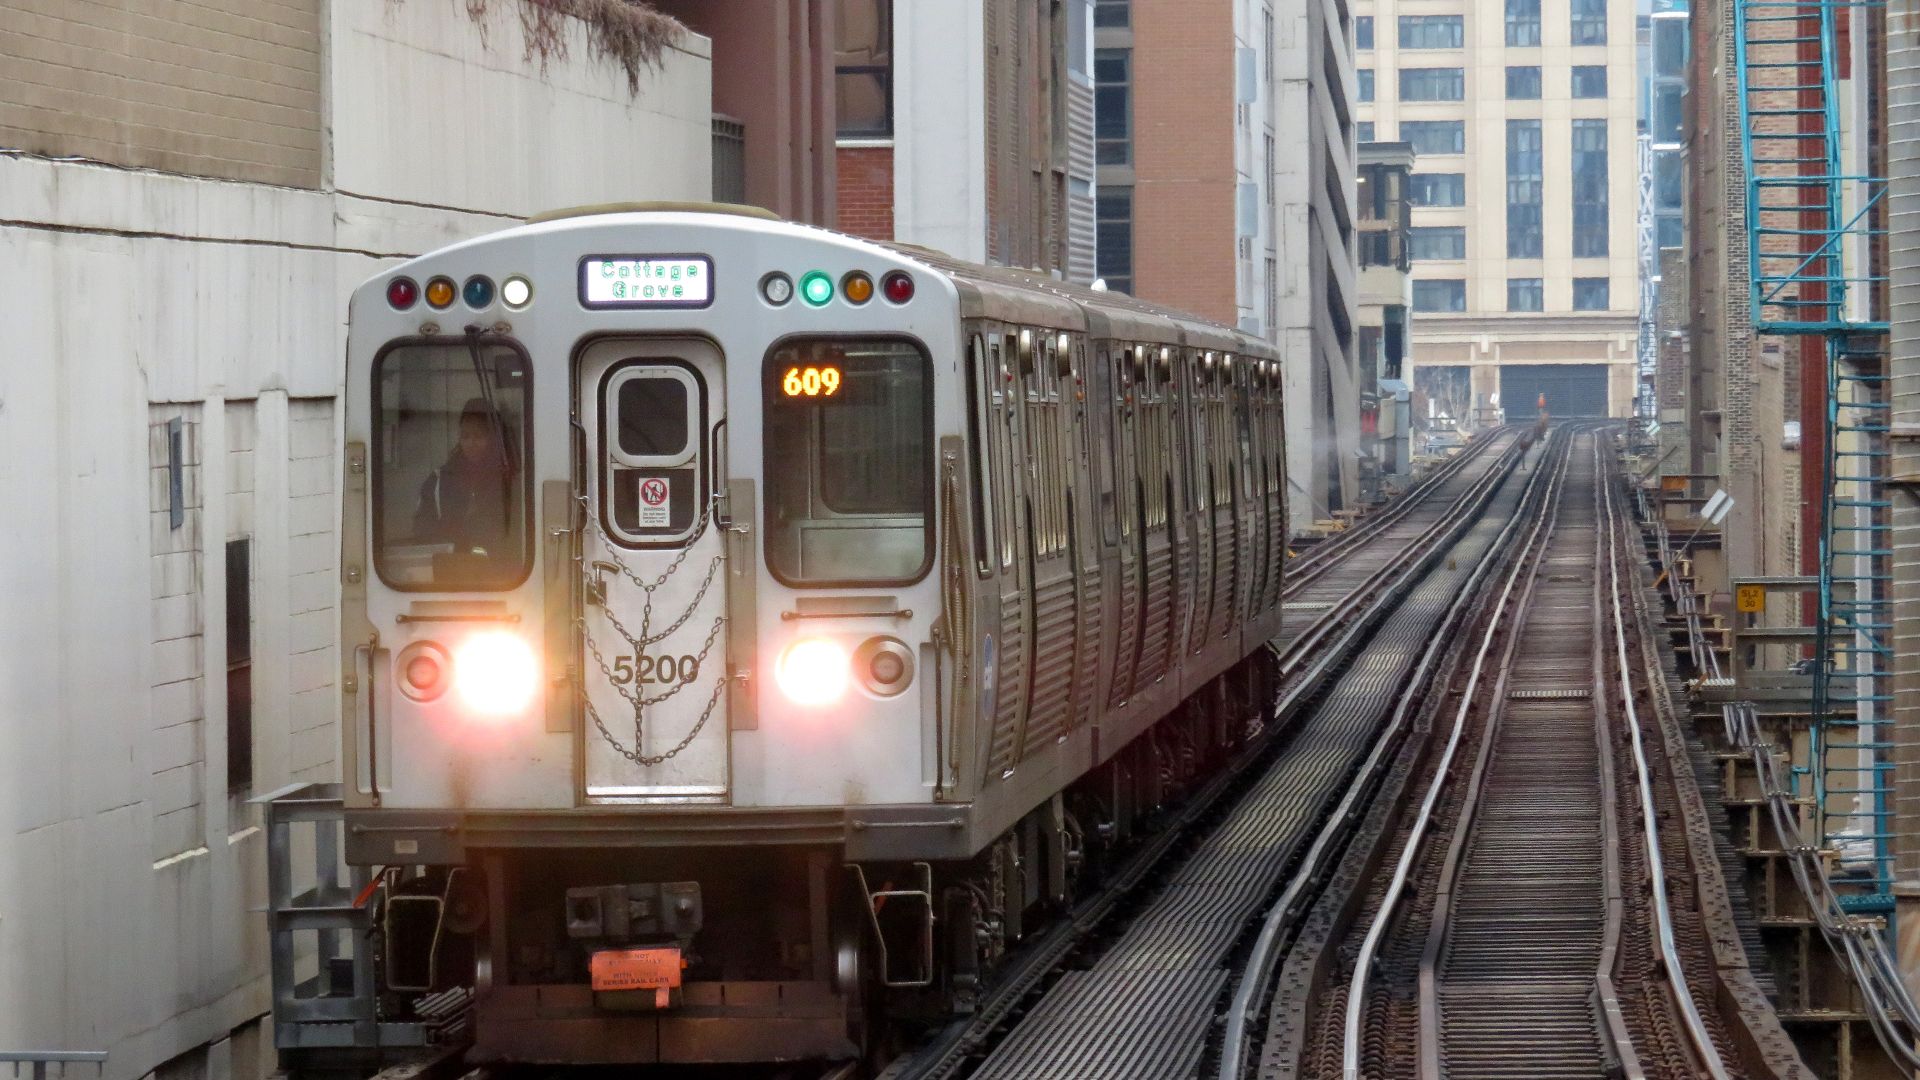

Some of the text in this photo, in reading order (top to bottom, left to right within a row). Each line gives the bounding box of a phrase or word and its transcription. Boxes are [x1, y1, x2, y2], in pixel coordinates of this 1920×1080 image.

[601, 261, 698, 280] Cottage
[612, 281, 683, 298] Grove
[783, 367, 840, 396] 609
[613, 654, 699, 684] 5200
